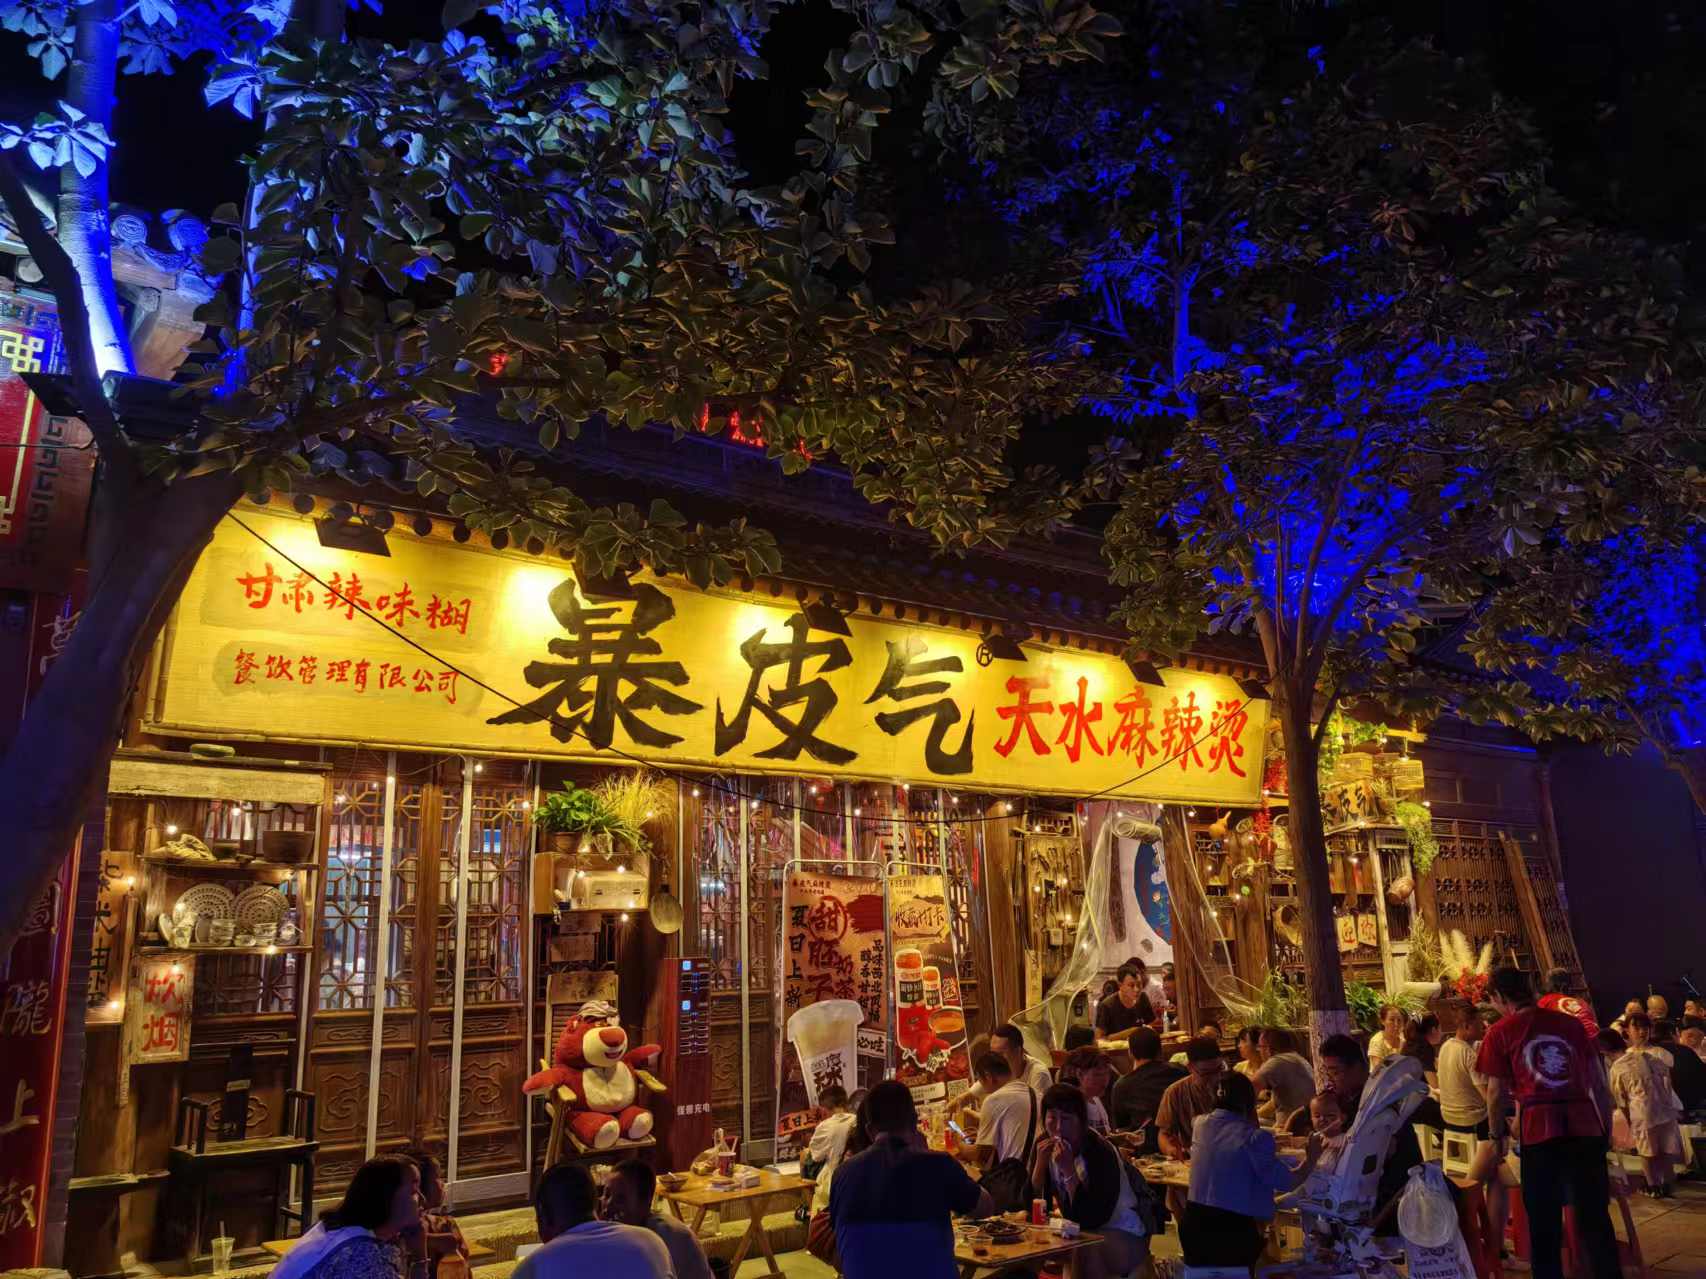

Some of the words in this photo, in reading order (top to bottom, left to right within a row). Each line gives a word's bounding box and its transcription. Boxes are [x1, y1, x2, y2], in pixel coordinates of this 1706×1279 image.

[236, 563, 473, 636] 甘肃辣味糊
[234, 648, 462, 704] 餐饮管理有限公司
[486, 577, 975, 775] 暴皮气
[994, 674, 1249, 778] 天水麻辣烫
[785, 904, 809, 1009] 夏日上新
